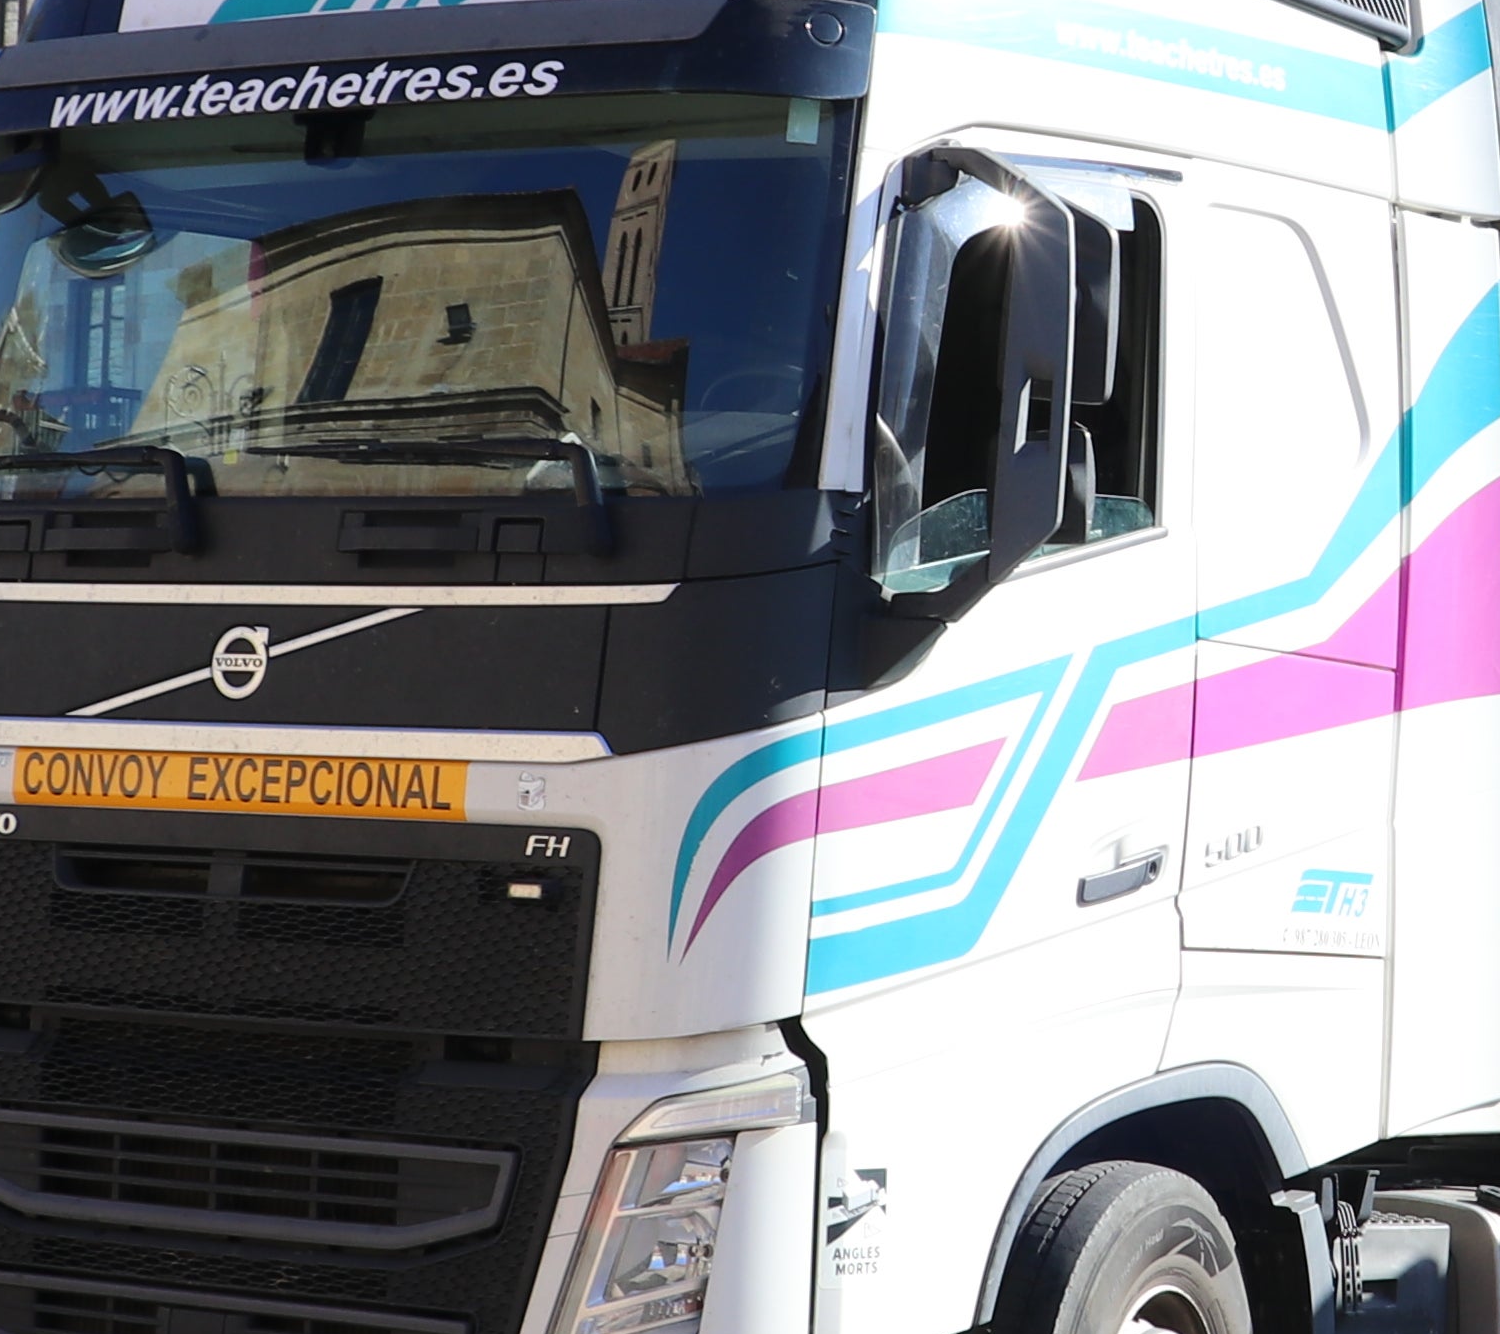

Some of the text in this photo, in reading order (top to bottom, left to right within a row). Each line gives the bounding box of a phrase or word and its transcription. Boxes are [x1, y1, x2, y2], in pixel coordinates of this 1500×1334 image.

[1055, 20, 1288, 92] www.teachetres.es
[48, 59, 566, 129] www.teachetres.es
[214, 656, 264, 669] VOLVO
[21, 751, 452, 812] CONVOY EXCEPCIONAL
[524, 834, 572, 858] FH
[1204, 825, 1263, 868] 500
[832, 1246, 881, 1261] ANGLES
[835, 1261, 879, 1276] MORTS
